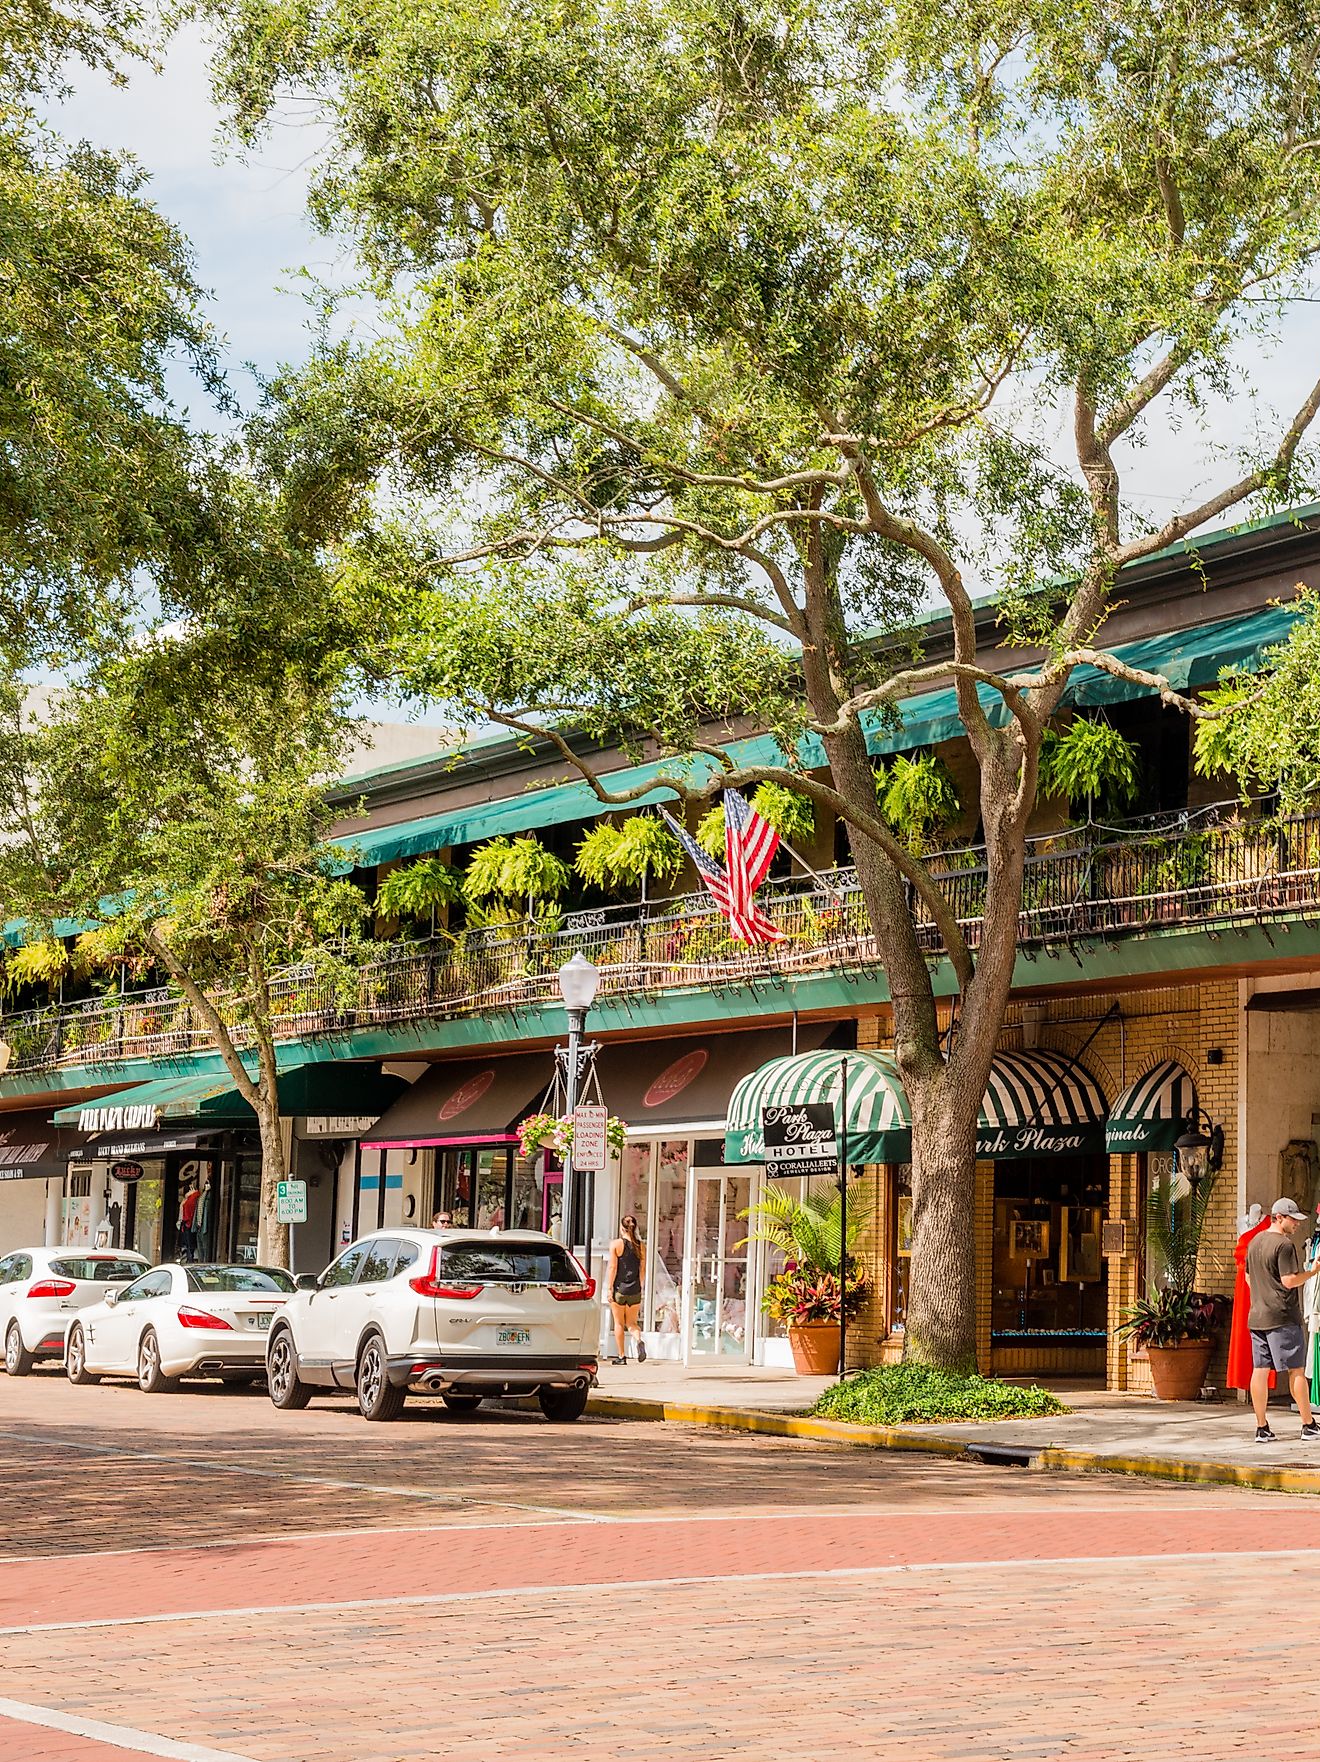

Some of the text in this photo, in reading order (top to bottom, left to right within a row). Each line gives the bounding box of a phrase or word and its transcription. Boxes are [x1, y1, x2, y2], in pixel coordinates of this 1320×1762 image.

[764, 1105, 808, 1126] Park
[784, 1122, 833, 1145] Plaza
[976, 1128, 1085, 1152] ark Plaza
[774, 1145, 829, 1157] HOTEL
[780, 1159, 837, 1170] CORALIALEETS
[280, 1185, 286, 1195] 3
